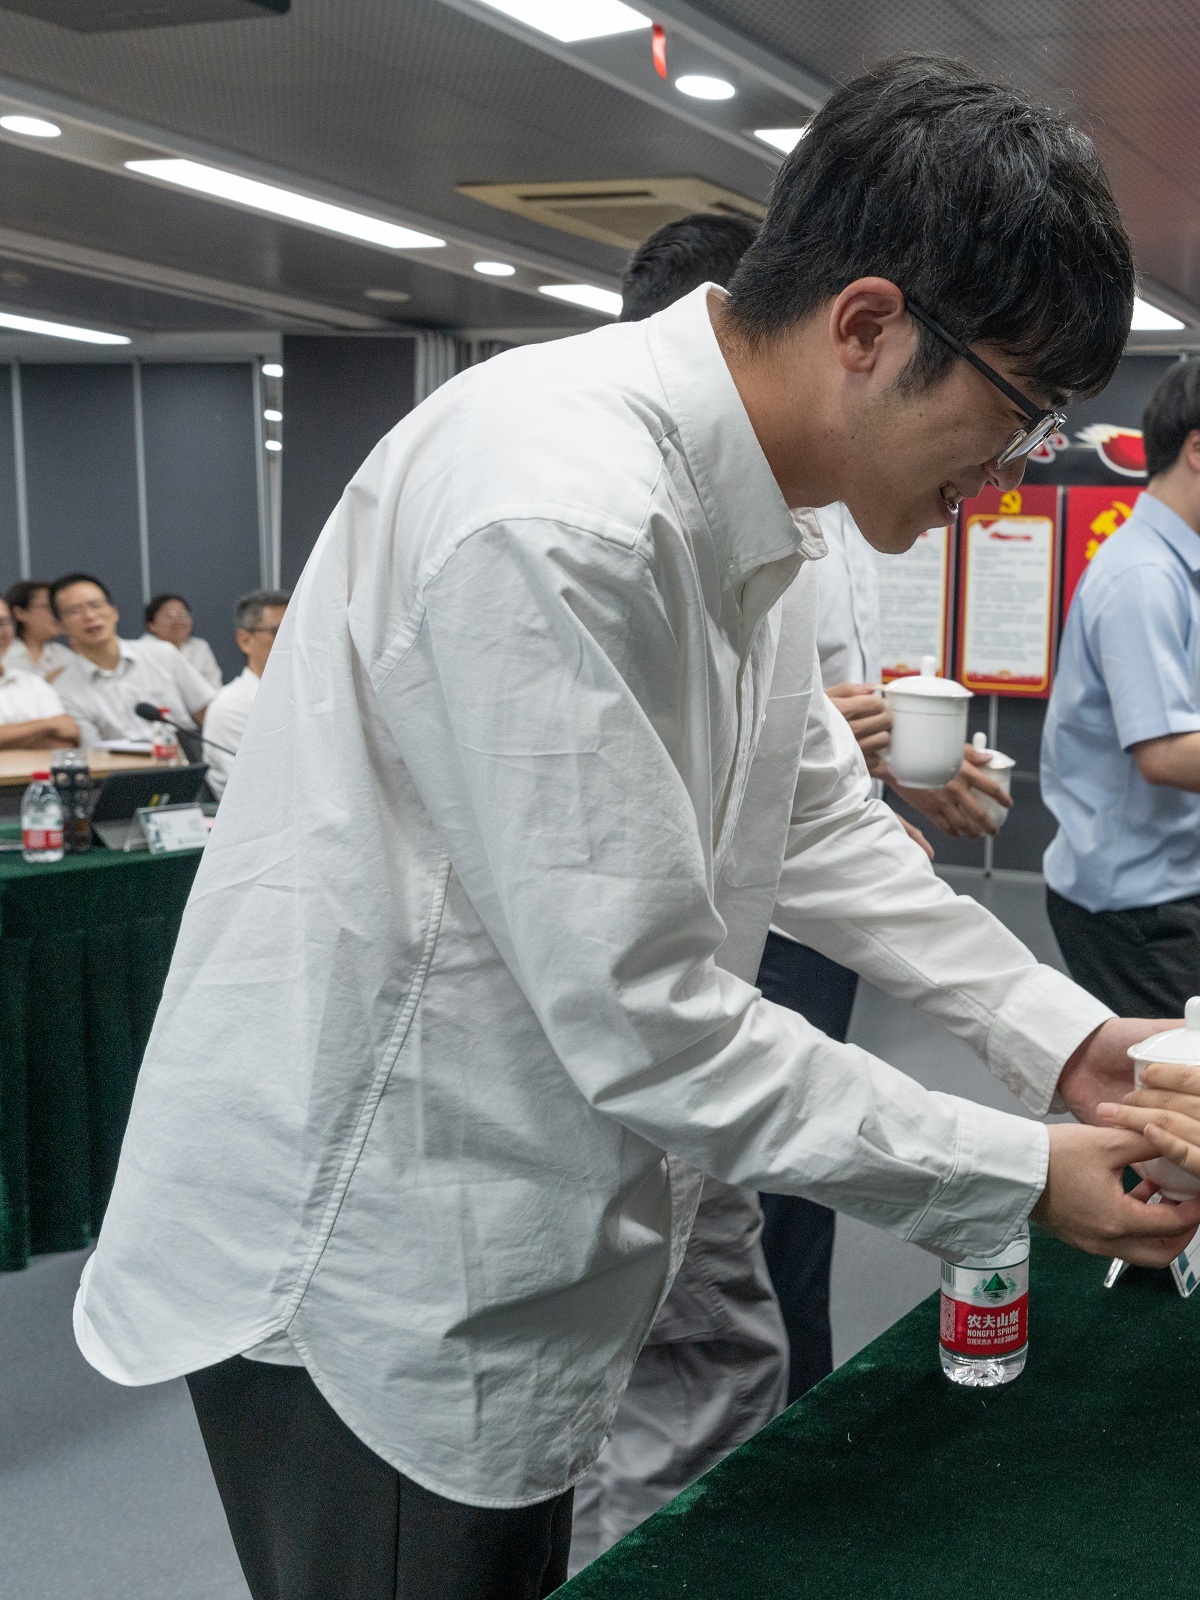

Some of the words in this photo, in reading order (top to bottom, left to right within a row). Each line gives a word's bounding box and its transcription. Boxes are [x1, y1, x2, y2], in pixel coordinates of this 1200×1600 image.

[967, 1309, 1019, 1329] 农夫山泉
[967, 1328, 995, 1338] NONGFU
[997, 1324, 1019, 1337] SPRING
